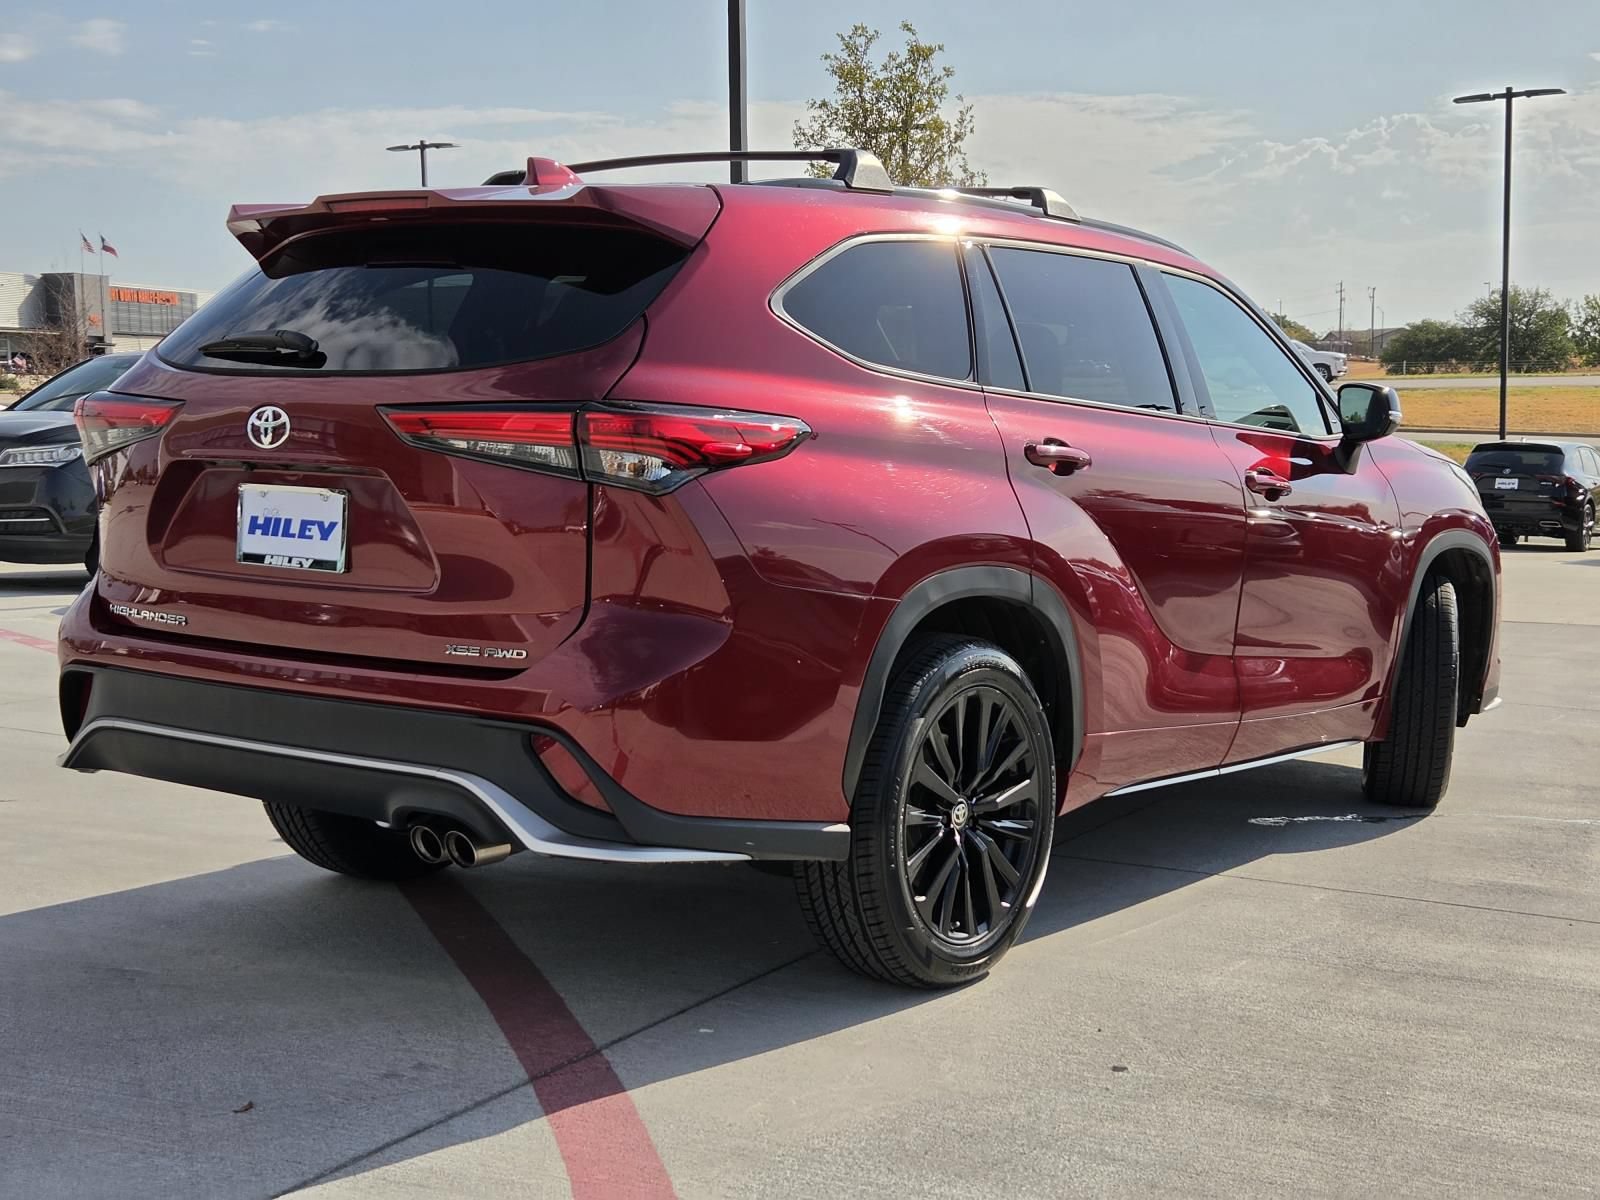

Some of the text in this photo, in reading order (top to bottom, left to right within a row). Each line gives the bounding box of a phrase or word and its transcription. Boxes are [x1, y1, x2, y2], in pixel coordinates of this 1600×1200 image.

[247, 515, 339, 541] HILEY
[264, 554, 315, 568] HILEY
[109, 603, 188, 626] HIGHLANDER
[445, 644, 527, 659] XSE AWD
